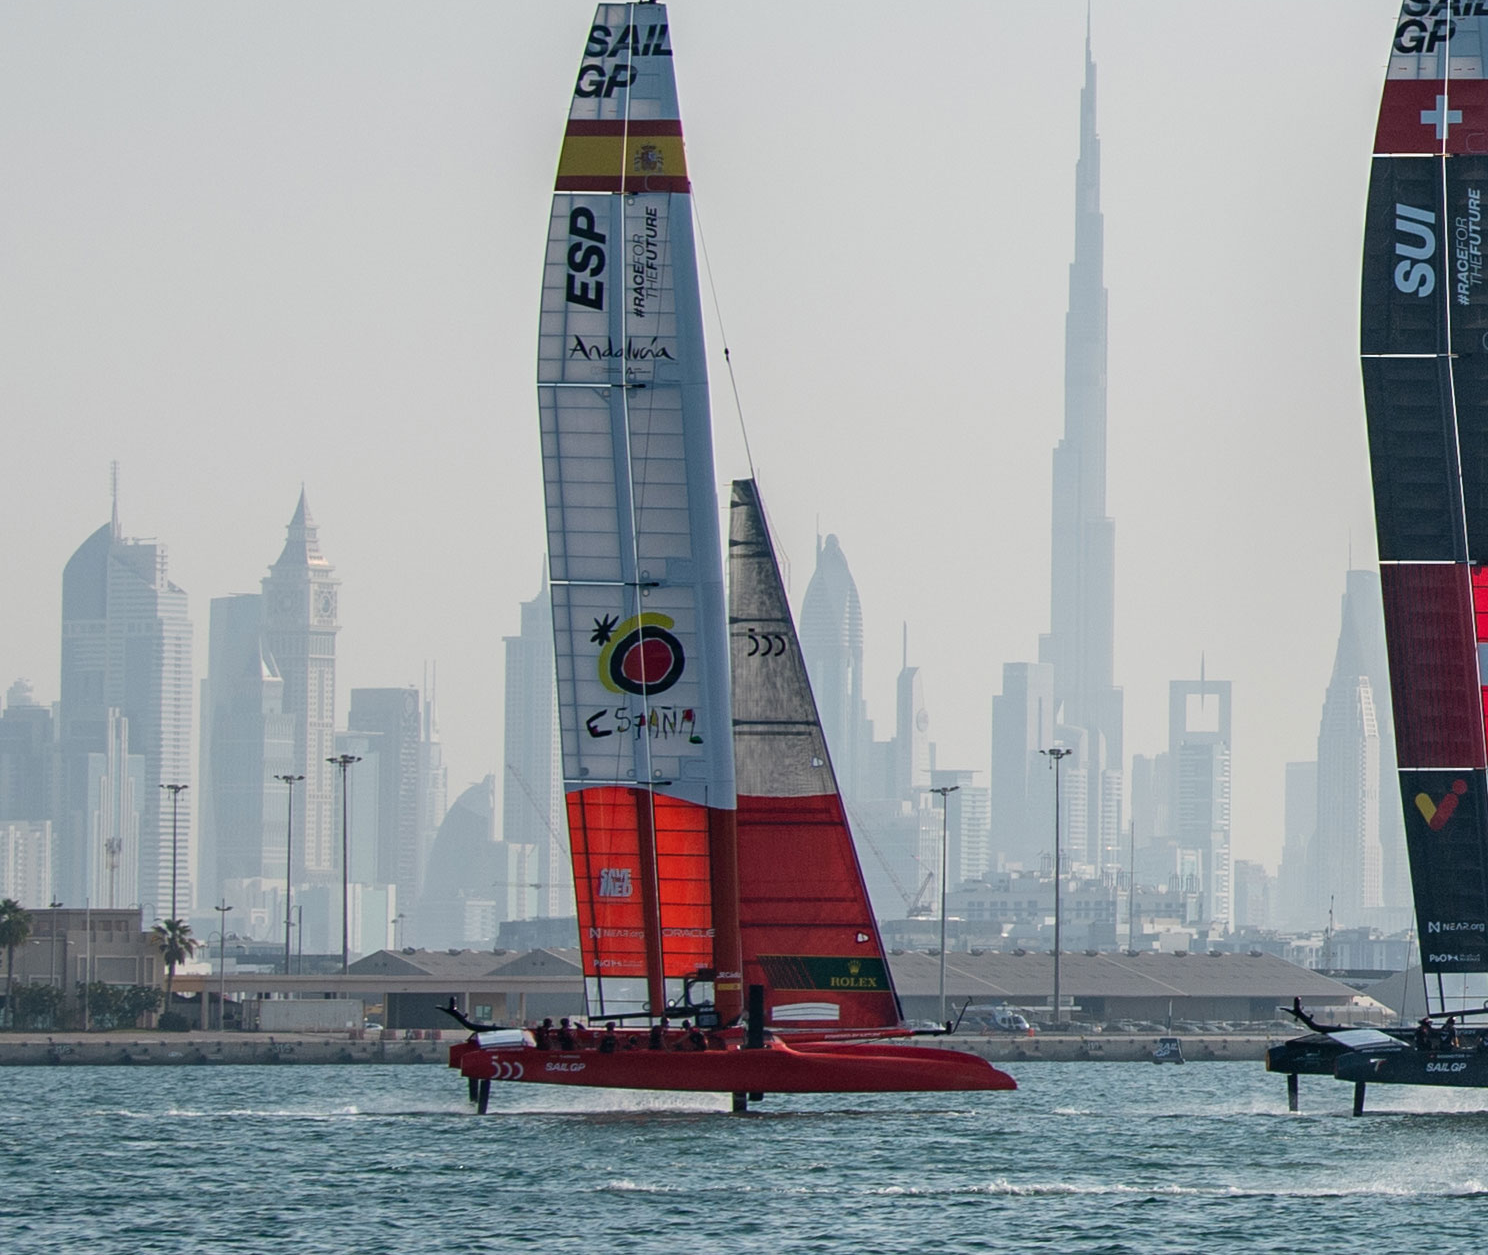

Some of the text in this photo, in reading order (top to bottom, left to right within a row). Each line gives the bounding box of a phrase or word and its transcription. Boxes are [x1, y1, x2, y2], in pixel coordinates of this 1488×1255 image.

[584, 24, 674, 57] SAIL
[1393, 19, 1456, 54] GP
[573, 64, 638, 98] GP
[566, 206, 607, 311] ESP
[1394, 203, 1436, 298] SUI
[662, 928, 716, 938] ORACLE
[830, 977, 877, 987] ROLEX
